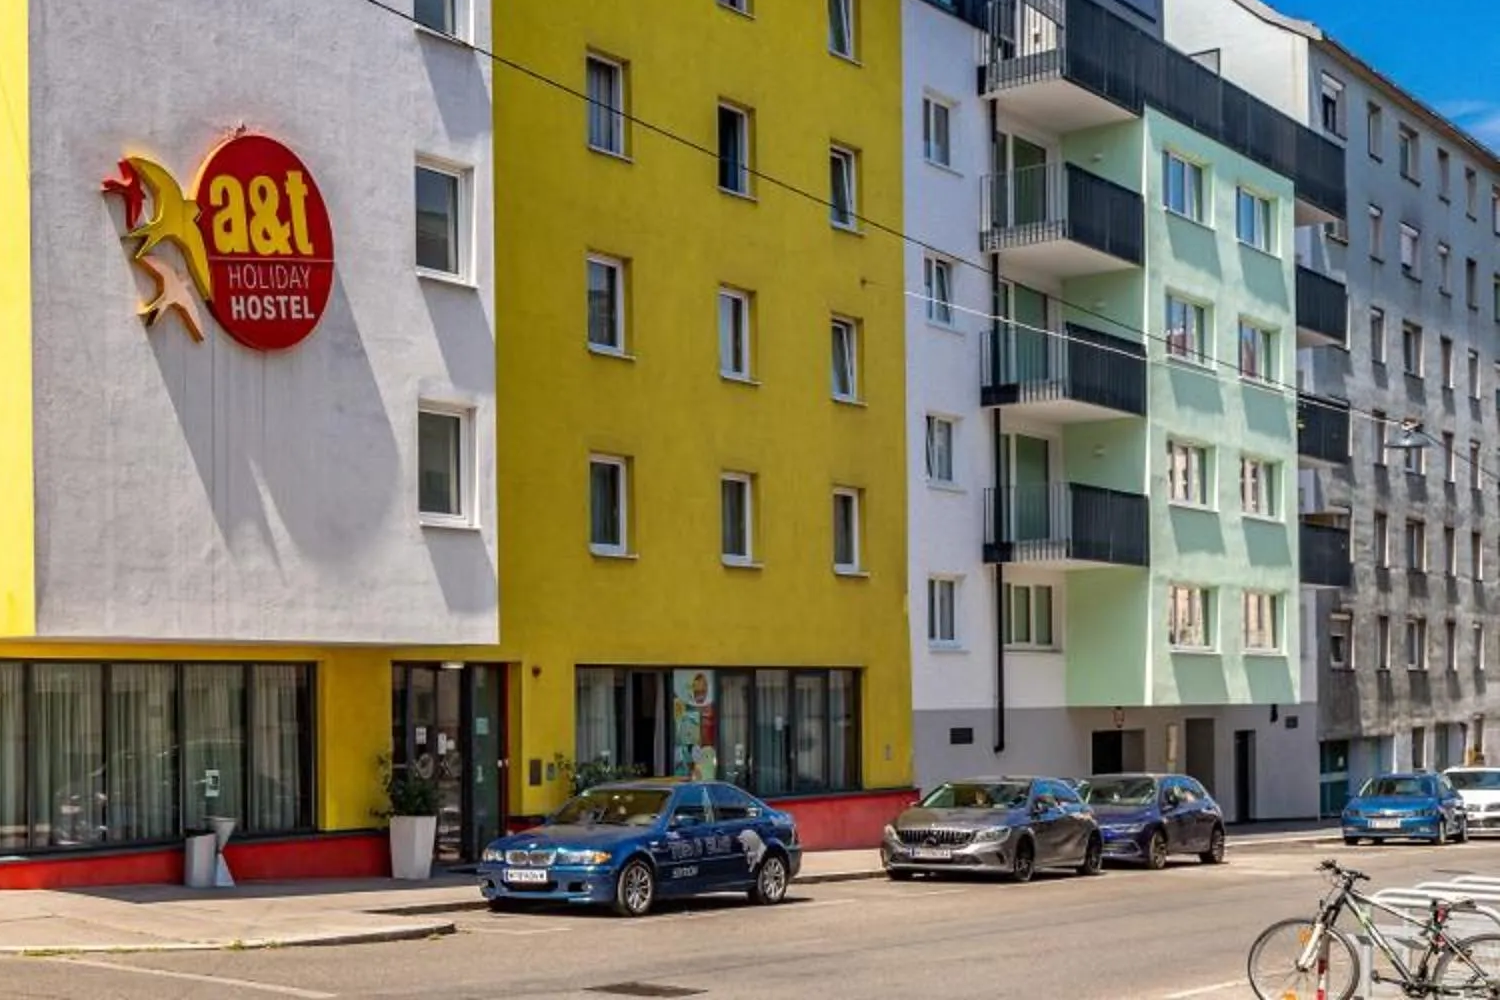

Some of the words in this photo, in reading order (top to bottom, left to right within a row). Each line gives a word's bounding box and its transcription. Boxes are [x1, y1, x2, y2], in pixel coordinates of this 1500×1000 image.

[209, 170, 314, 256] a&t
[228, 264, 311, 290] HOLIDAY
[231, 295, 315, 321] HOSTEL
